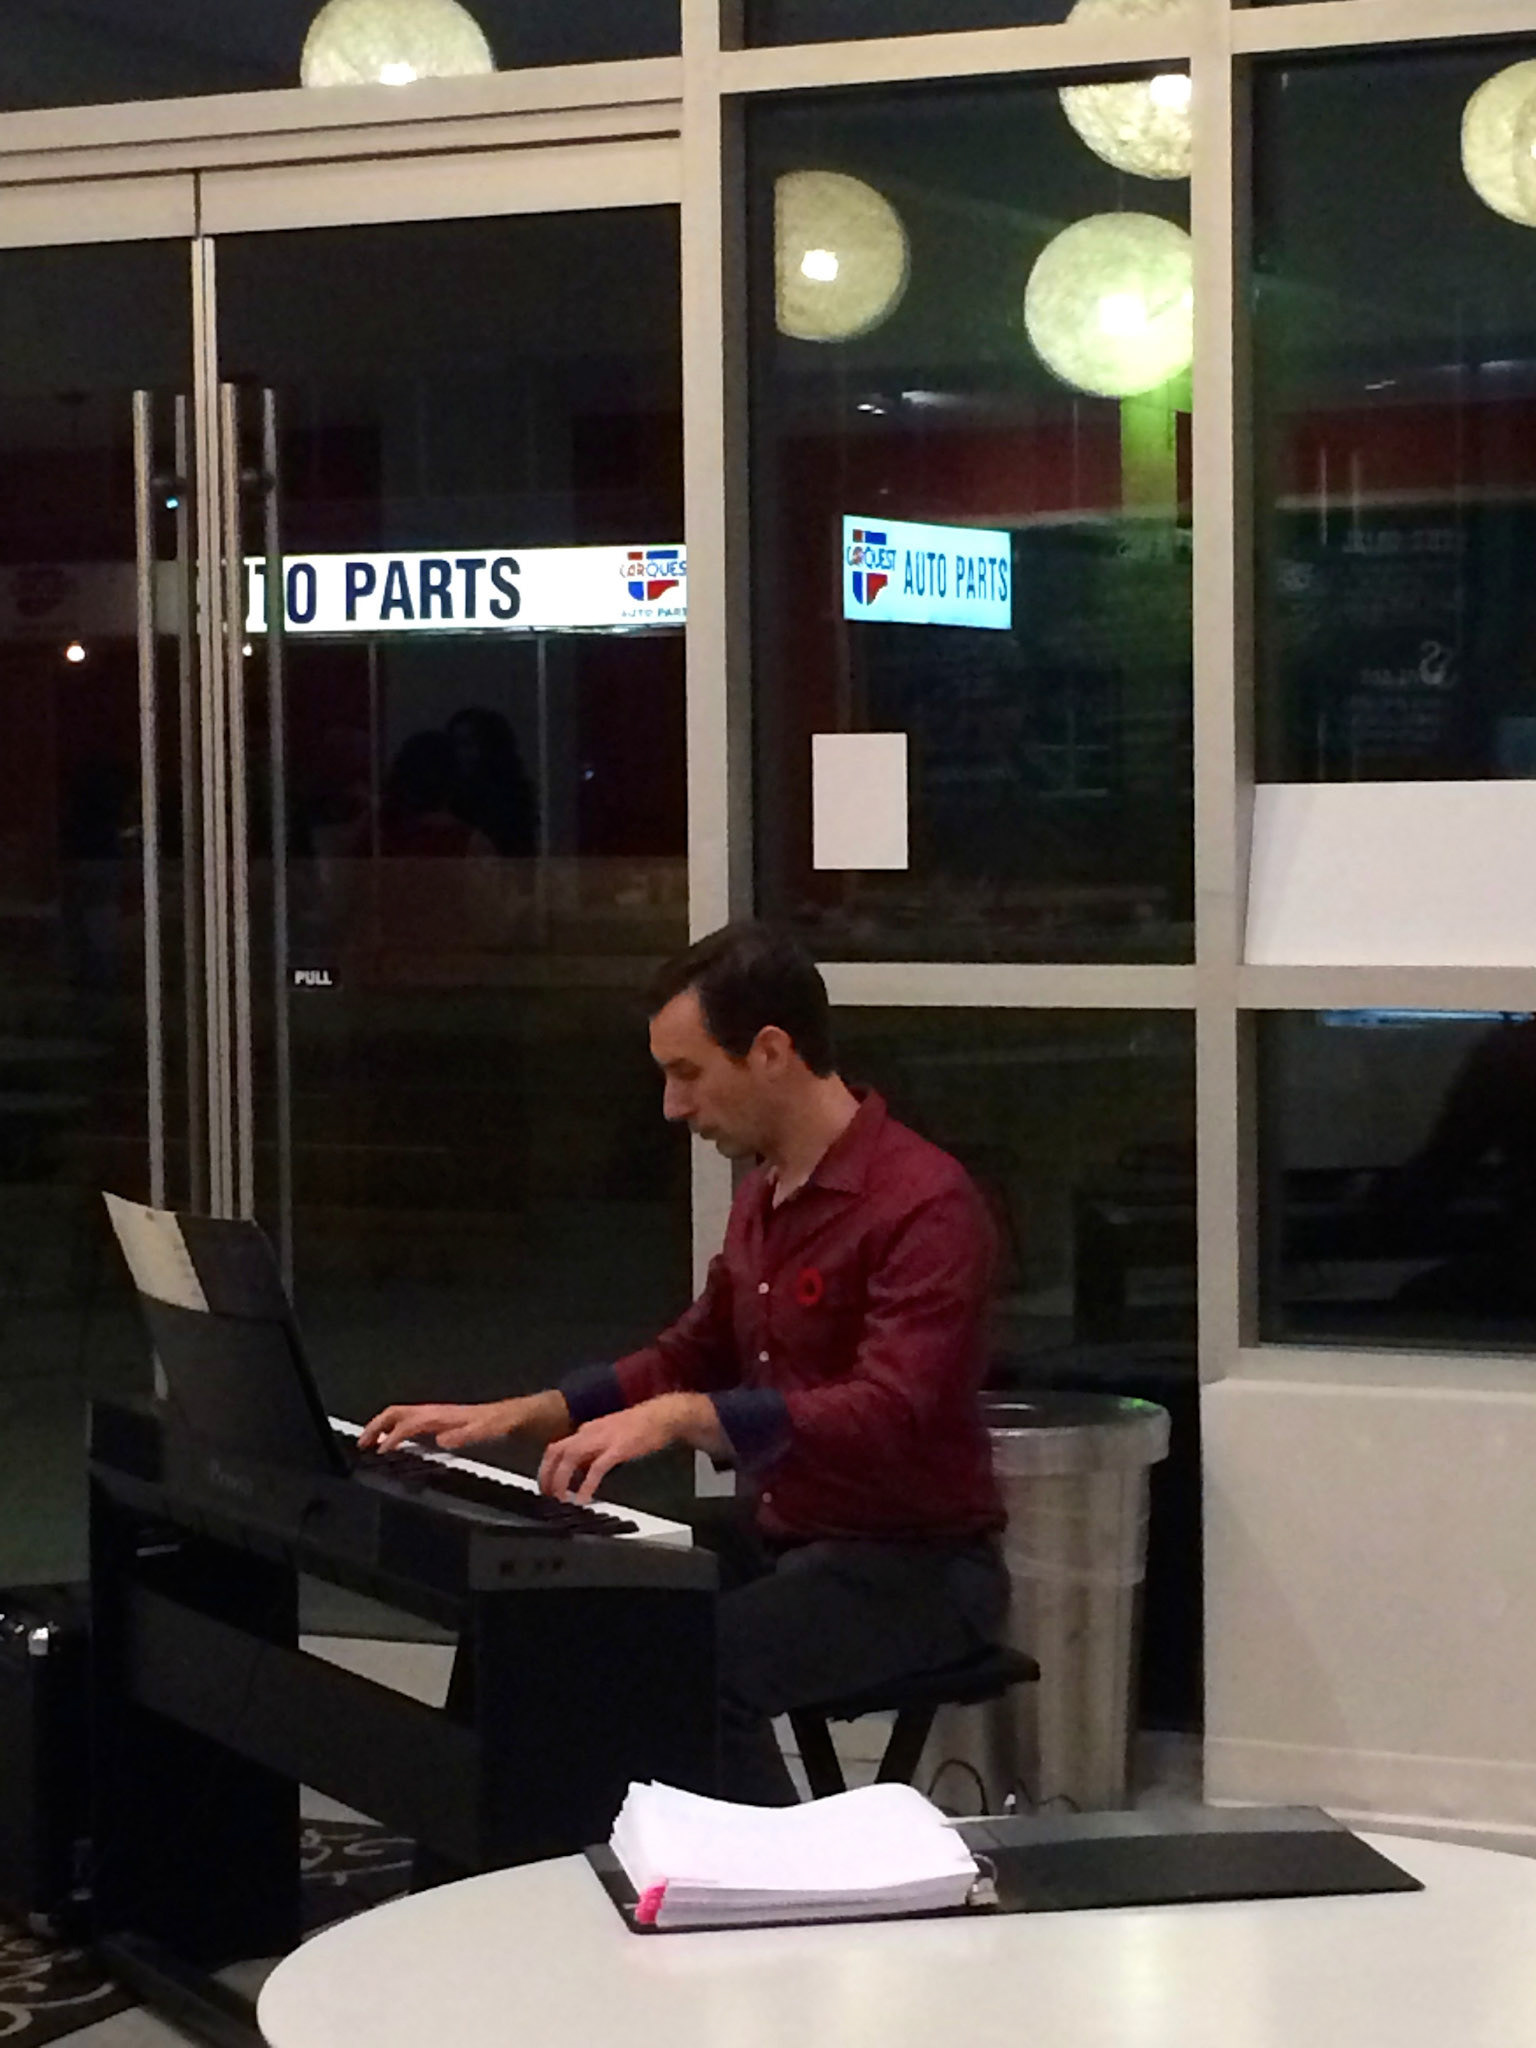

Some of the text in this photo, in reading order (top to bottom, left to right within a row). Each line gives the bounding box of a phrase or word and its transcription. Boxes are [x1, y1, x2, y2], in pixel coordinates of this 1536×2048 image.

[619, 560, 688, 578] CARQUES
[904, 550, 1008, 602] AUTO PARTS
[345, 556, 521, 622] PARTS
[658, 608, 688, 617] PART
[294, 970, 333, 985] PULL
